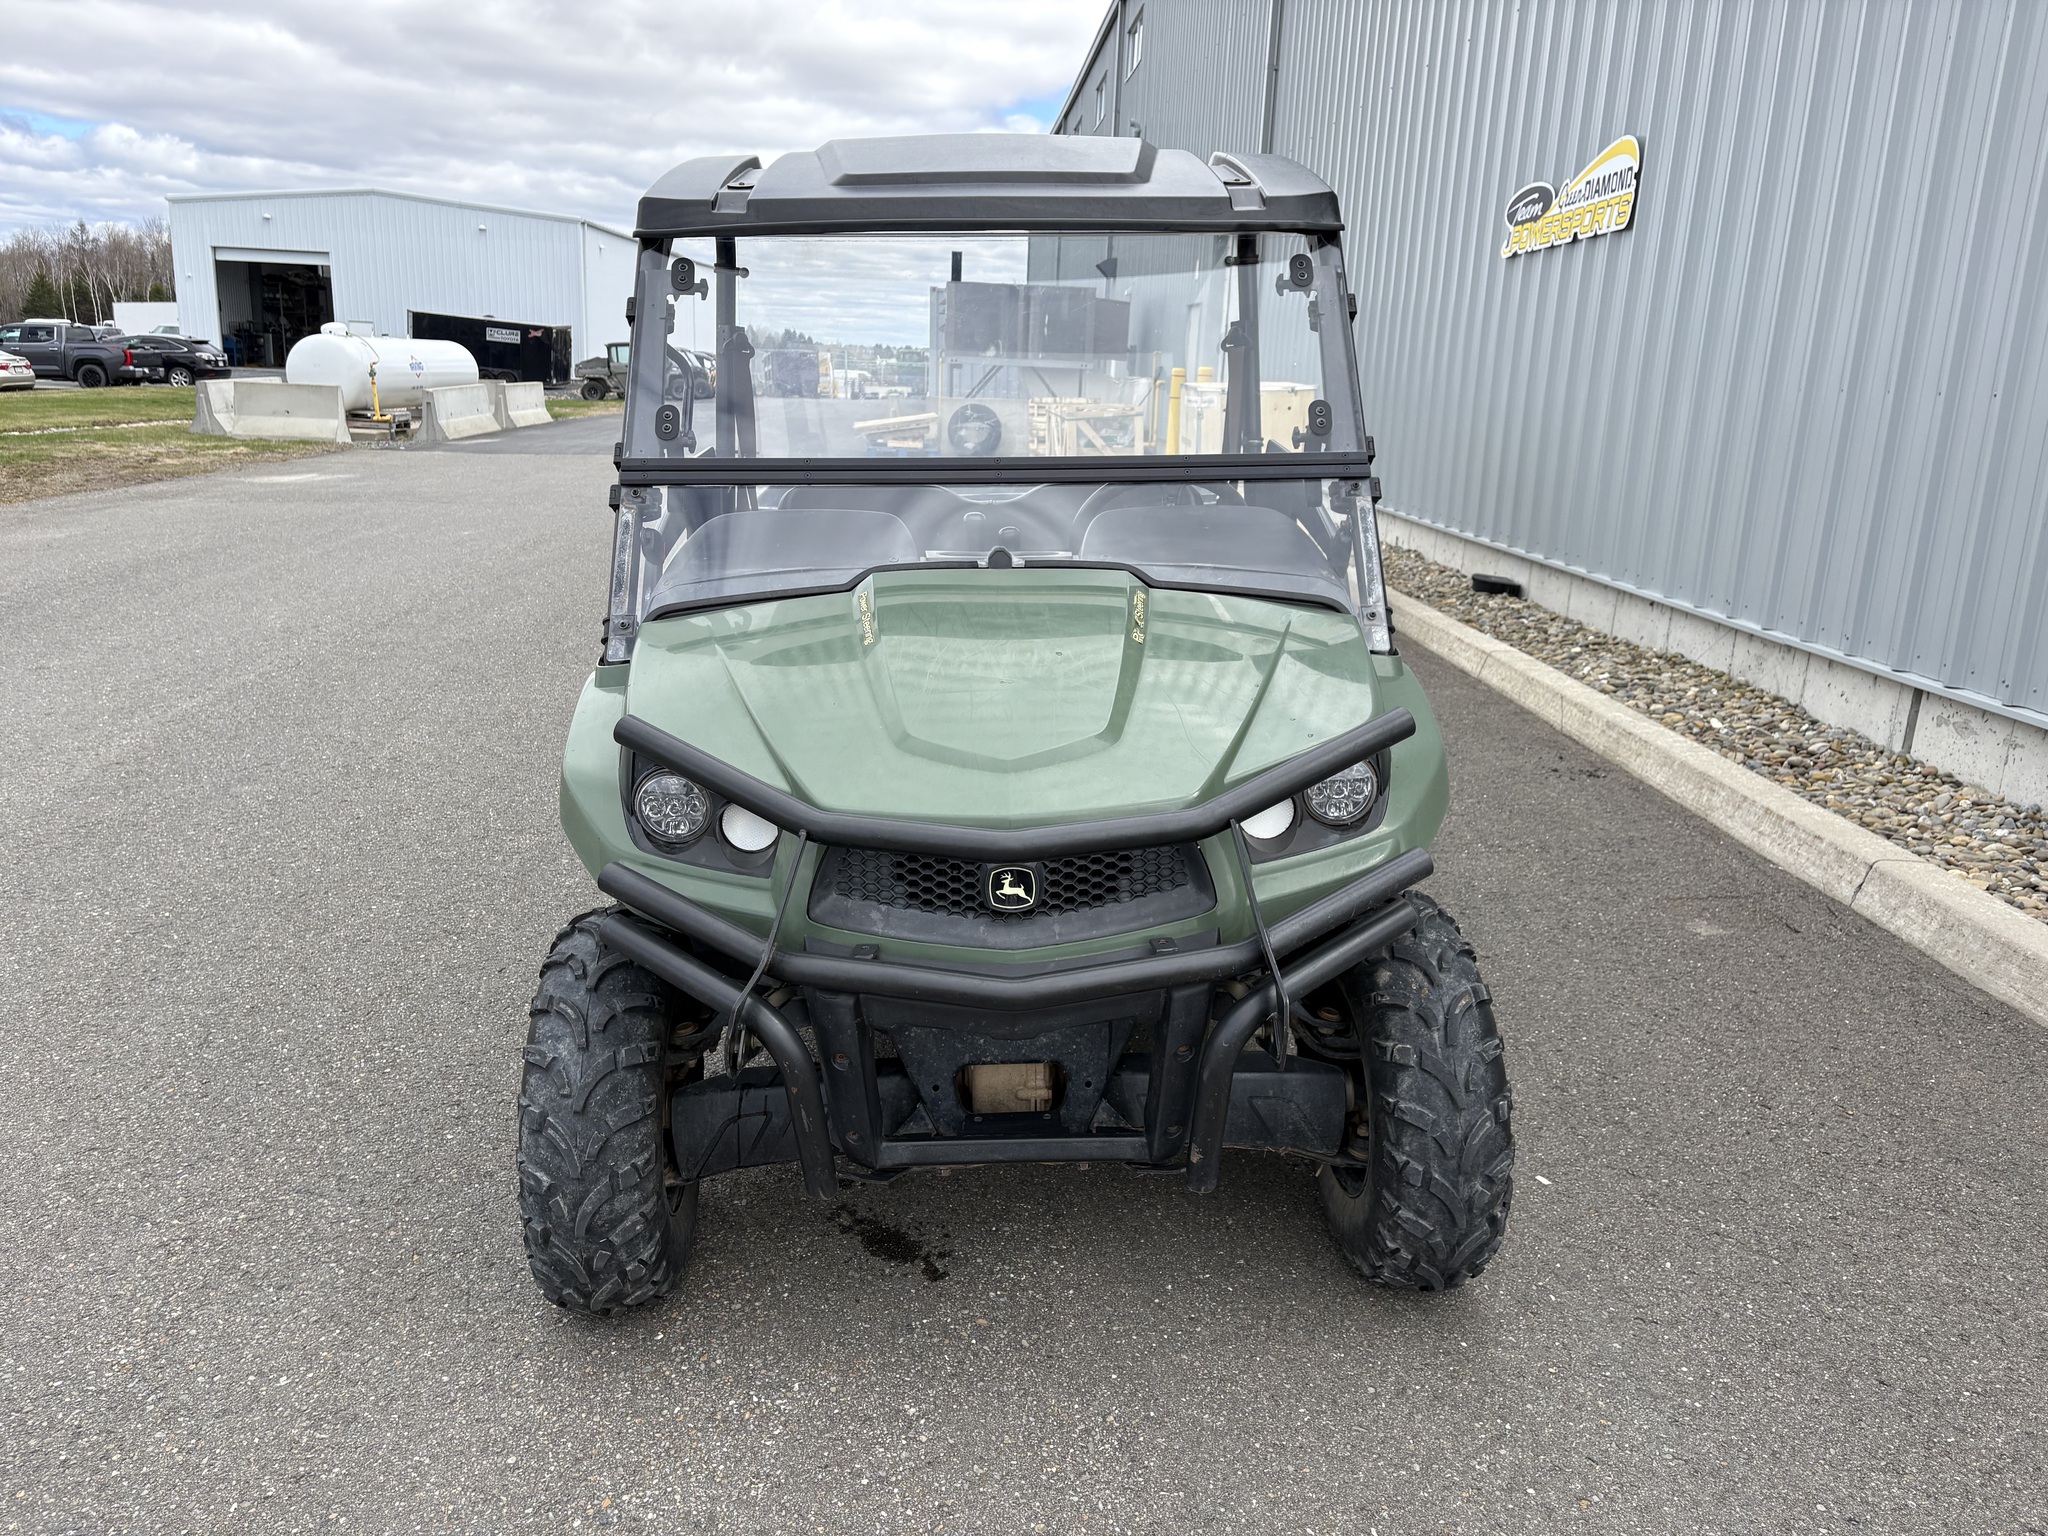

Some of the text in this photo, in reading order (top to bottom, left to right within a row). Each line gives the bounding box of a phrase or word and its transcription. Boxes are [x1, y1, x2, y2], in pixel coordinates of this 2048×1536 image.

[1584, 166, 1635, 202] DIAMOND
[1503, 192, 1633, 255] POWERSPORTS
[1508, 193, 1543, 226] Team
[859, 591, 868, 612] Power
